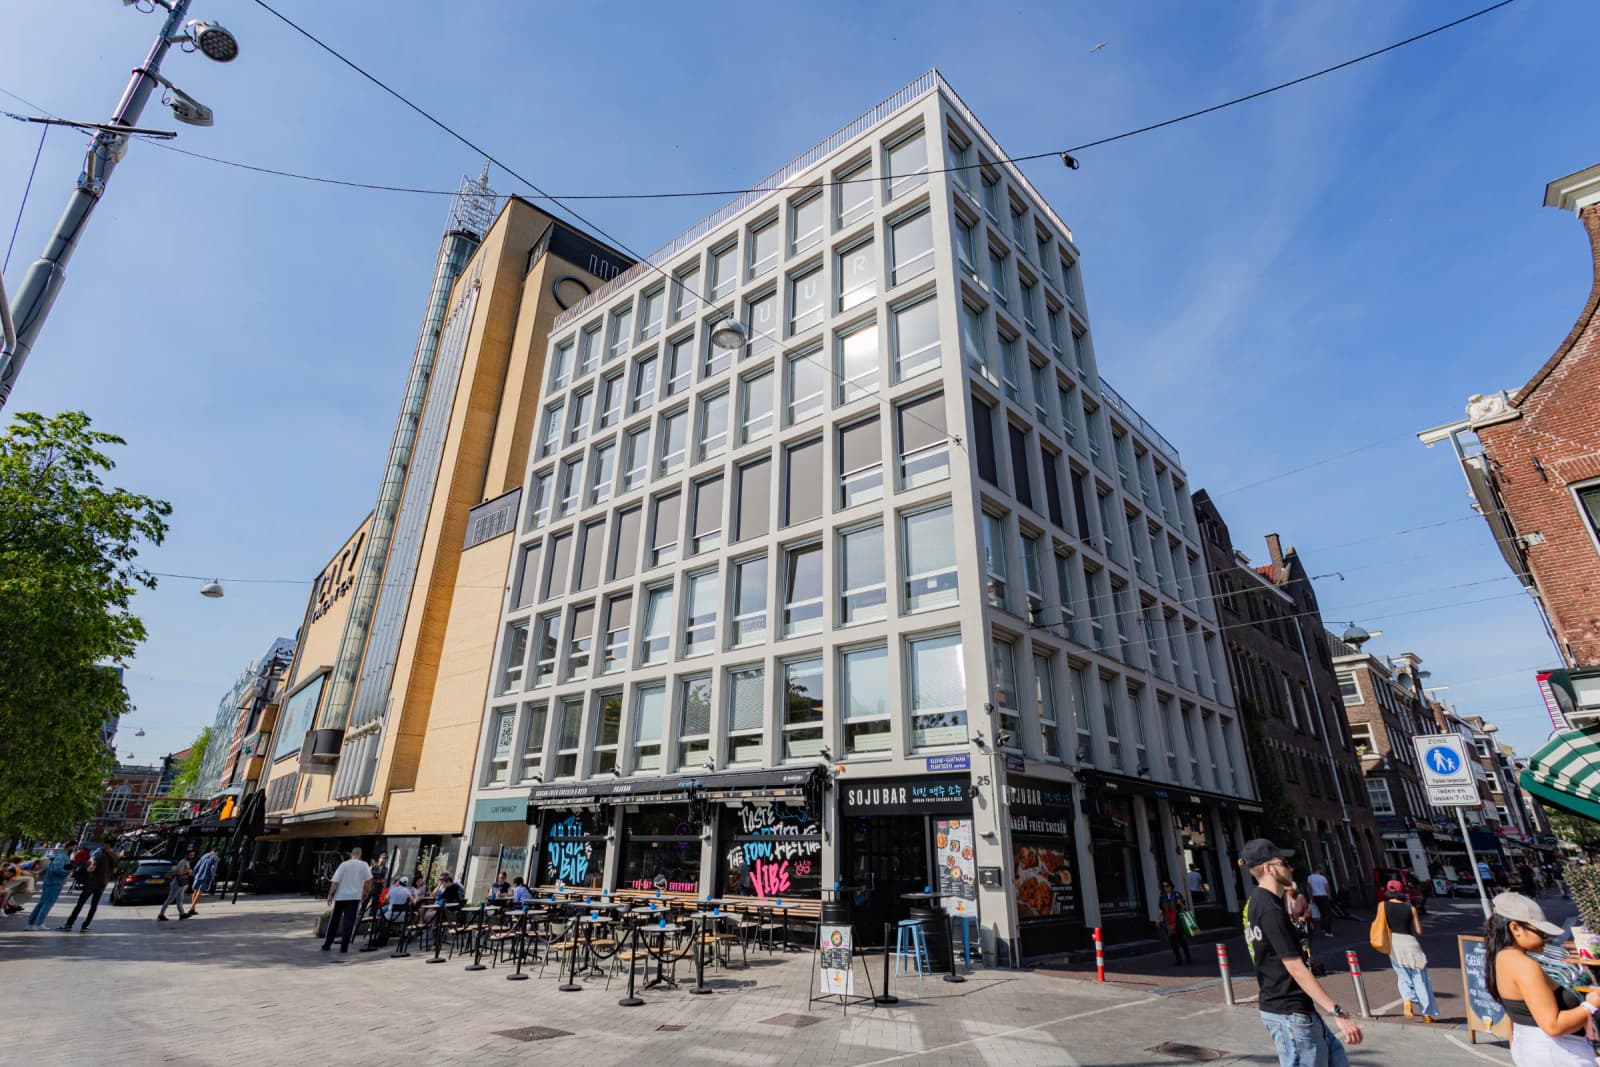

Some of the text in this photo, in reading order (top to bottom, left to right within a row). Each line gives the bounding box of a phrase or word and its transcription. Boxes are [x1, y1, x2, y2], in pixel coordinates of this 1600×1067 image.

[318, 532, 366, 604] CITY
[977, 776, 990, 786] 25
[737, 803, 776, 833] TASTE
[748, 859, 791, 900] VIBE
